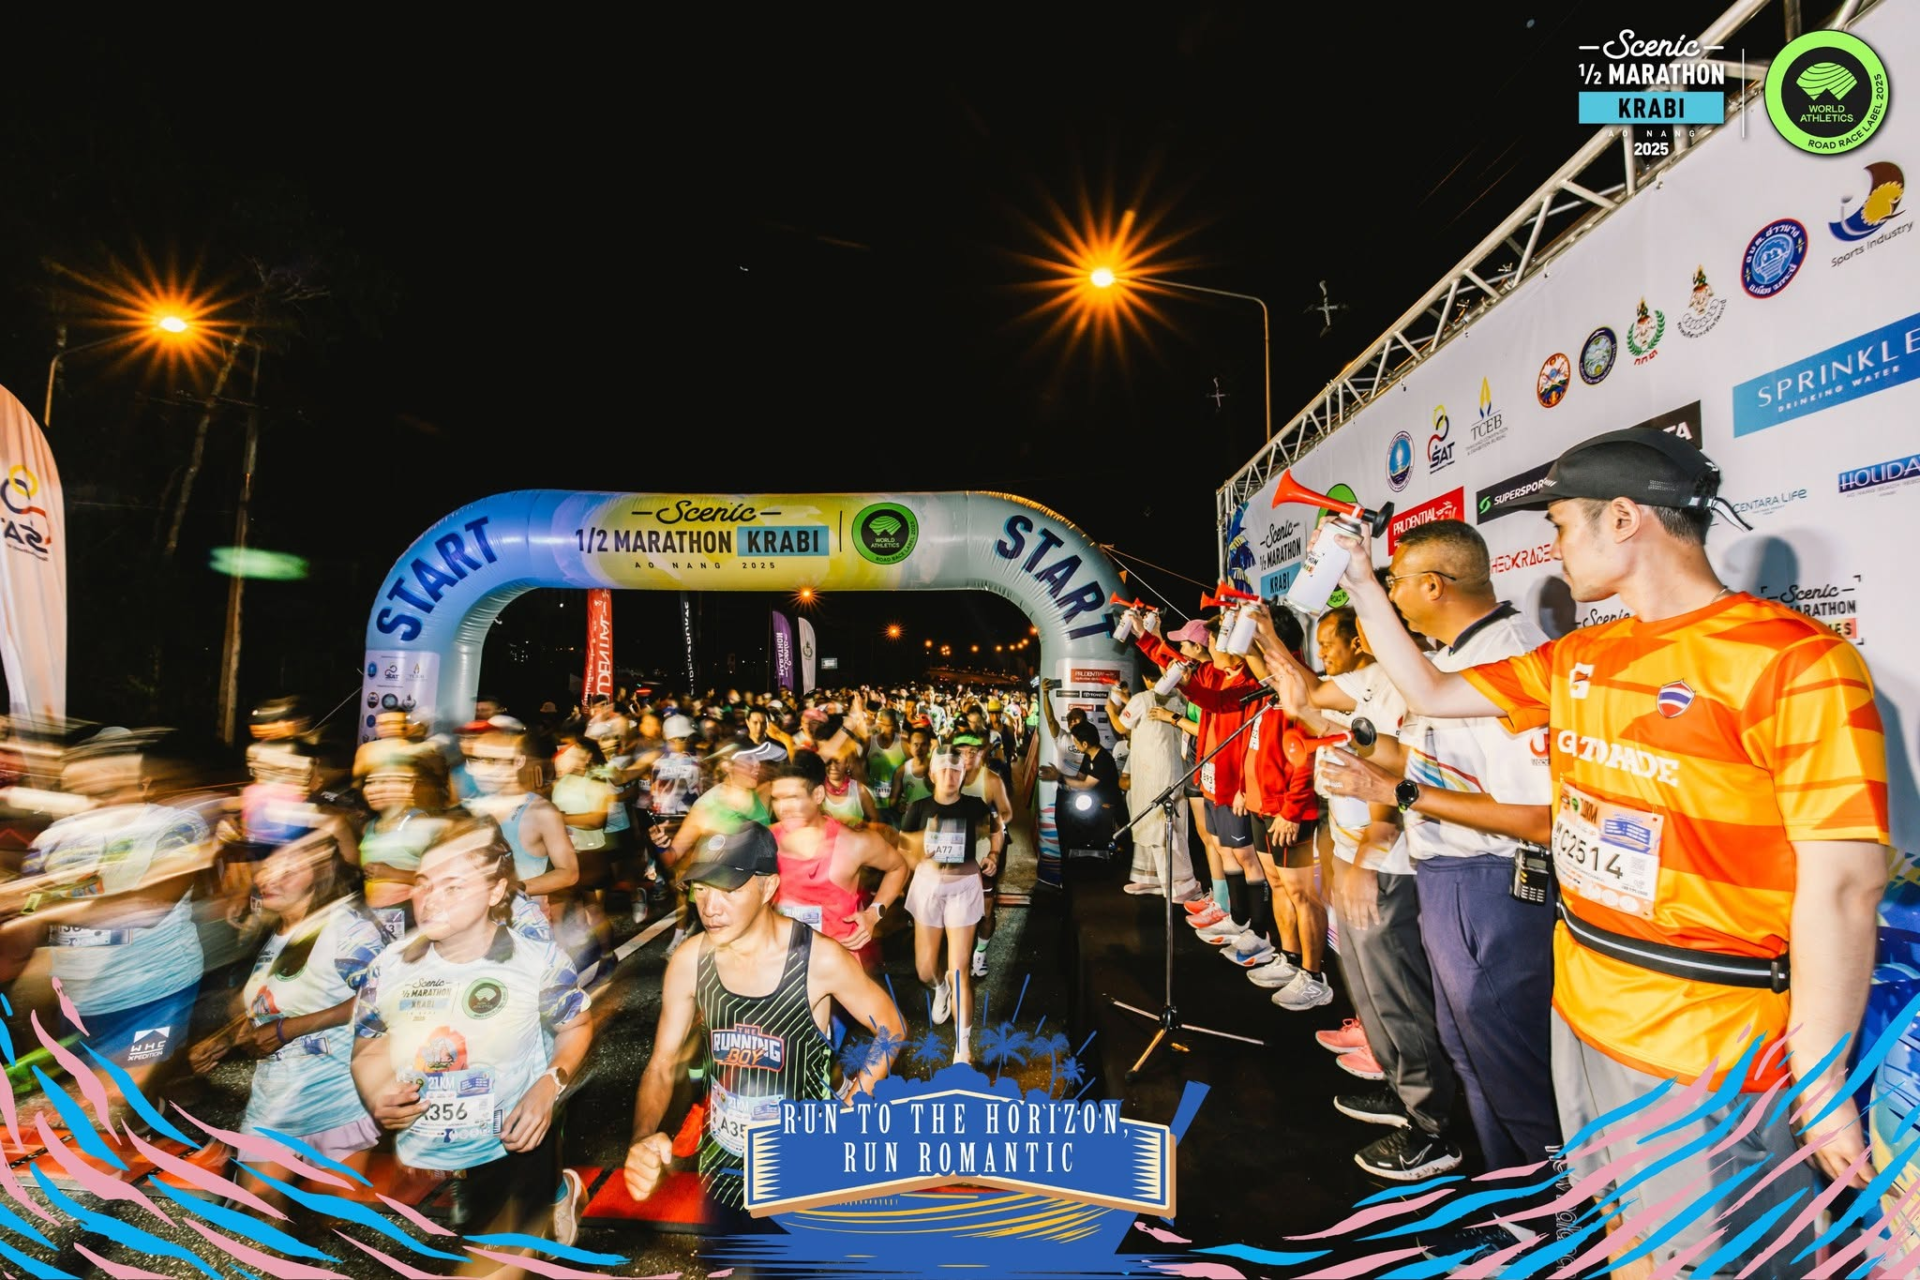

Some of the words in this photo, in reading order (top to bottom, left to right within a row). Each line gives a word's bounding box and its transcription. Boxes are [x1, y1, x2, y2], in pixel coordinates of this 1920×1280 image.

[1831, 244, 1865, 268] Sports
[1866, 221, 1914, 251] Industry
[1778, 384, 1844, 412] DRINKING
[1851, 365, 1900, 387] WATER
[1470, 413, 1503, 441] TCEB
[1430, 441, 1455, 468] SAT
[1839, 456, 1920, 490] HOLIDA
[1494, 478, 1546, 506] SUPERSPOR
[656, 500, 757, 525] Scenic
[1393, 507, 1438, 536] PRUDENTIAL
[575, 527, 609, 554] 1/2
[613, 529, 732, 554] MARATHON
[747, 529, 819, 554] KRABI
[1265, 520, 1294, 548] Scenic
[634, 561, 655, 570] AO
[672, 561, 721, 570] NANG
[742, 561, 776, 569] 2025
[1266, 536, 1302, 568] MARATHON
[1490, 543, 1551, 574] HECKRACE
[376, 515, 498, 642] START
[995, 514, 1116, 640] START
[1269, 571, 1290, 594] KRABI
[1780, 584, 1840, 603] Scenic
[1790, 600, 1857, 618] ARATHON
[936, 845, 953, 854] A77
[411, 988, 452, 997] MARATHON
[738, 1027, 757, 1035] THE
[713, 1033, 781, 1063] RUNNING
[725, 1048, 765, 1066] BOY
[423, 1102, 468, 1121] 356
[720, 1116, 746, 1138] A35
